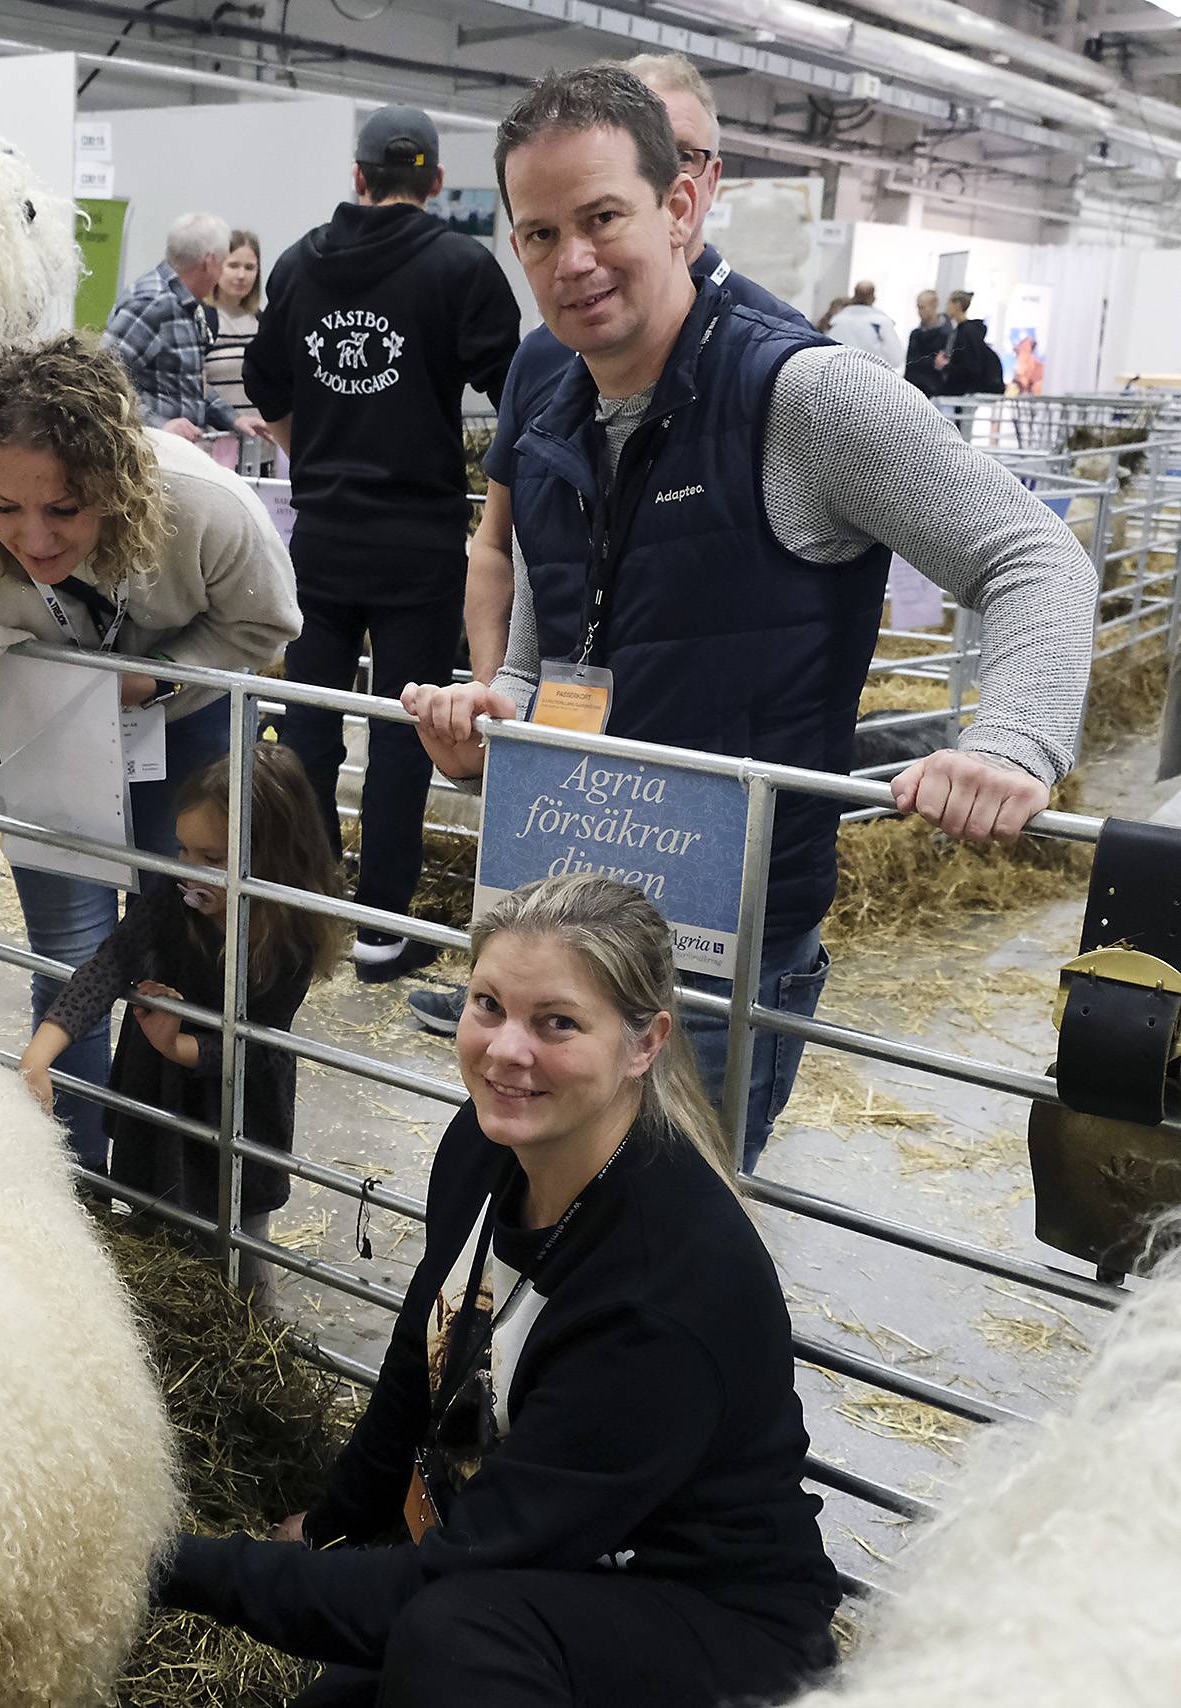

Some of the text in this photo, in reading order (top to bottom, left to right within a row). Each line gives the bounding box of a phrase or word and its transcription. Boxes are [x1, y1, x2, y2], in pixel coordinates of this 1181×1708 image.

[321, 310, 389, 332] VÄSTBO
[313, 364, 399, 394] MJÖLKGÅRD
[655, 484, 705, 504] Adapteo.
[559, 755, 666, 804] Agria
[516, 794, 701, 856] försäkrar
